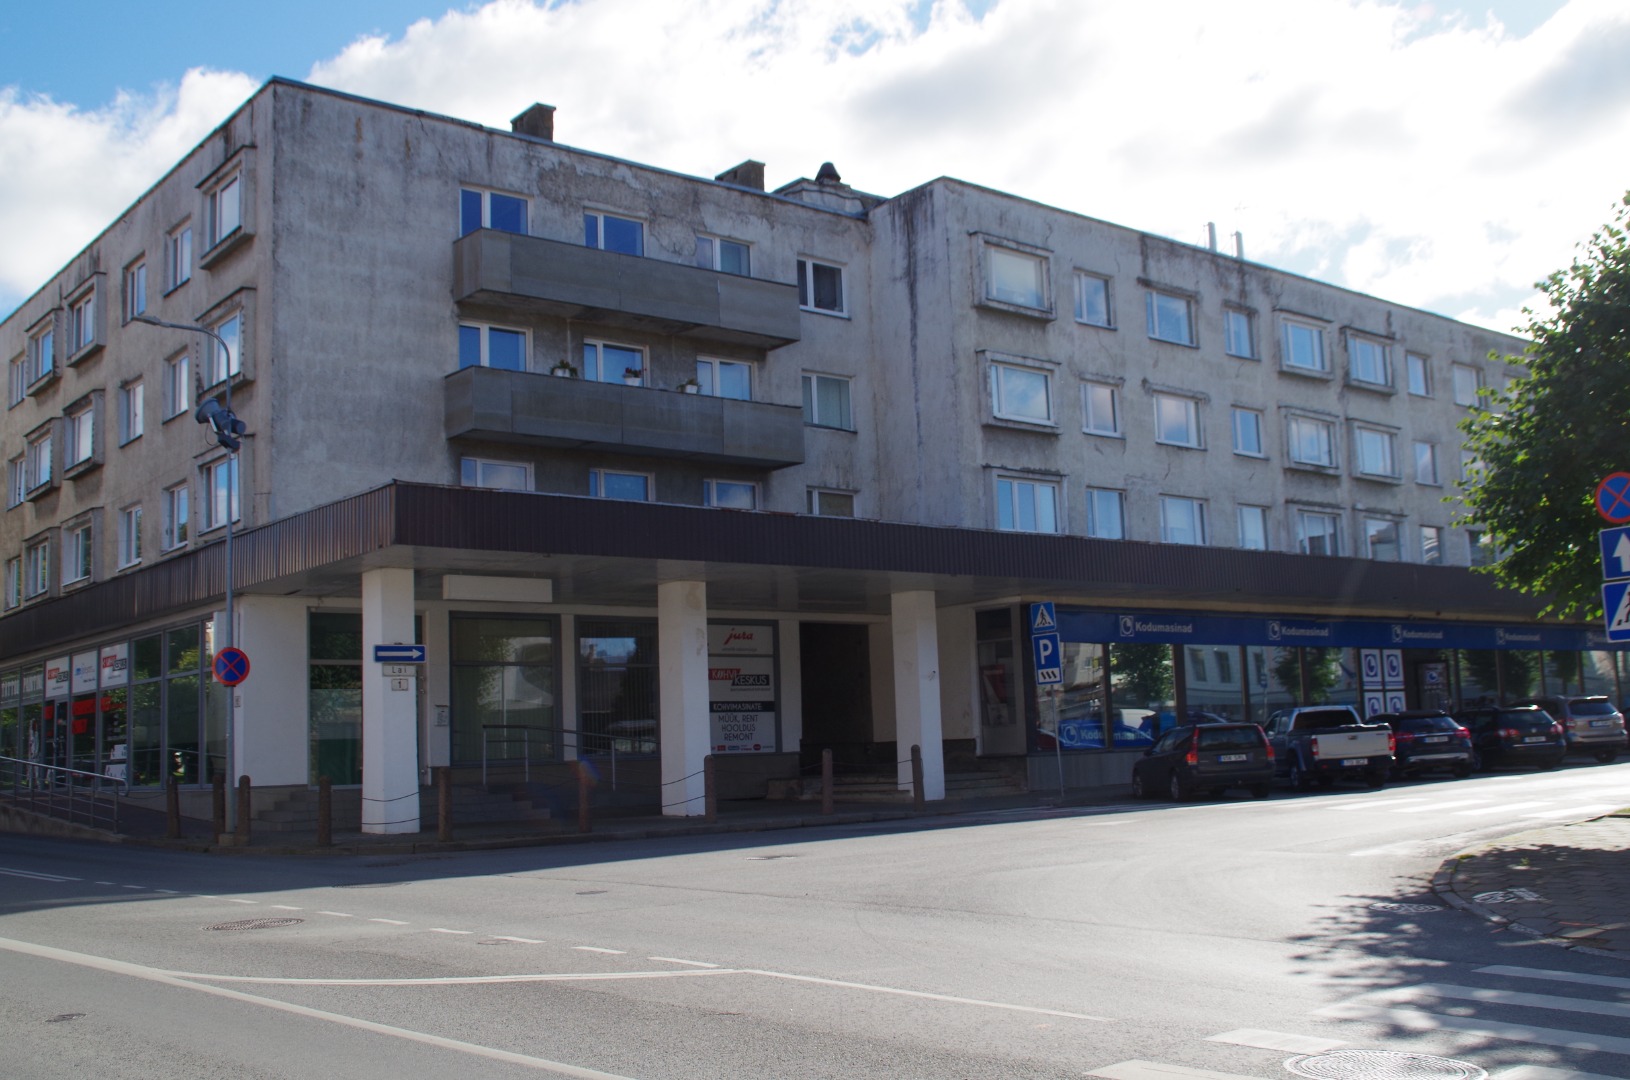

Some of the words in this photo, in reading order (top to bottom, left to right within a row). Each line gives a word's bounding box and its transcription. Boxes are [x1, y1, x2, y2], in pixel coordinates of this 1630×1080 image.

[1135, 621, 1193, 633] Kodumasinad
[723, 627, 754, 646] jura
[1039, 639, 1053, 665] P
[391, 666, 407, 674] Lai
[397, 680, 402, 689] 1
[734, 675, 767, 685] KESKUS
[742, 714, 758, 722] RENT
[721, 724, 756, 732] HOOLDUS
[724, 733, 754, 741] REMONT
